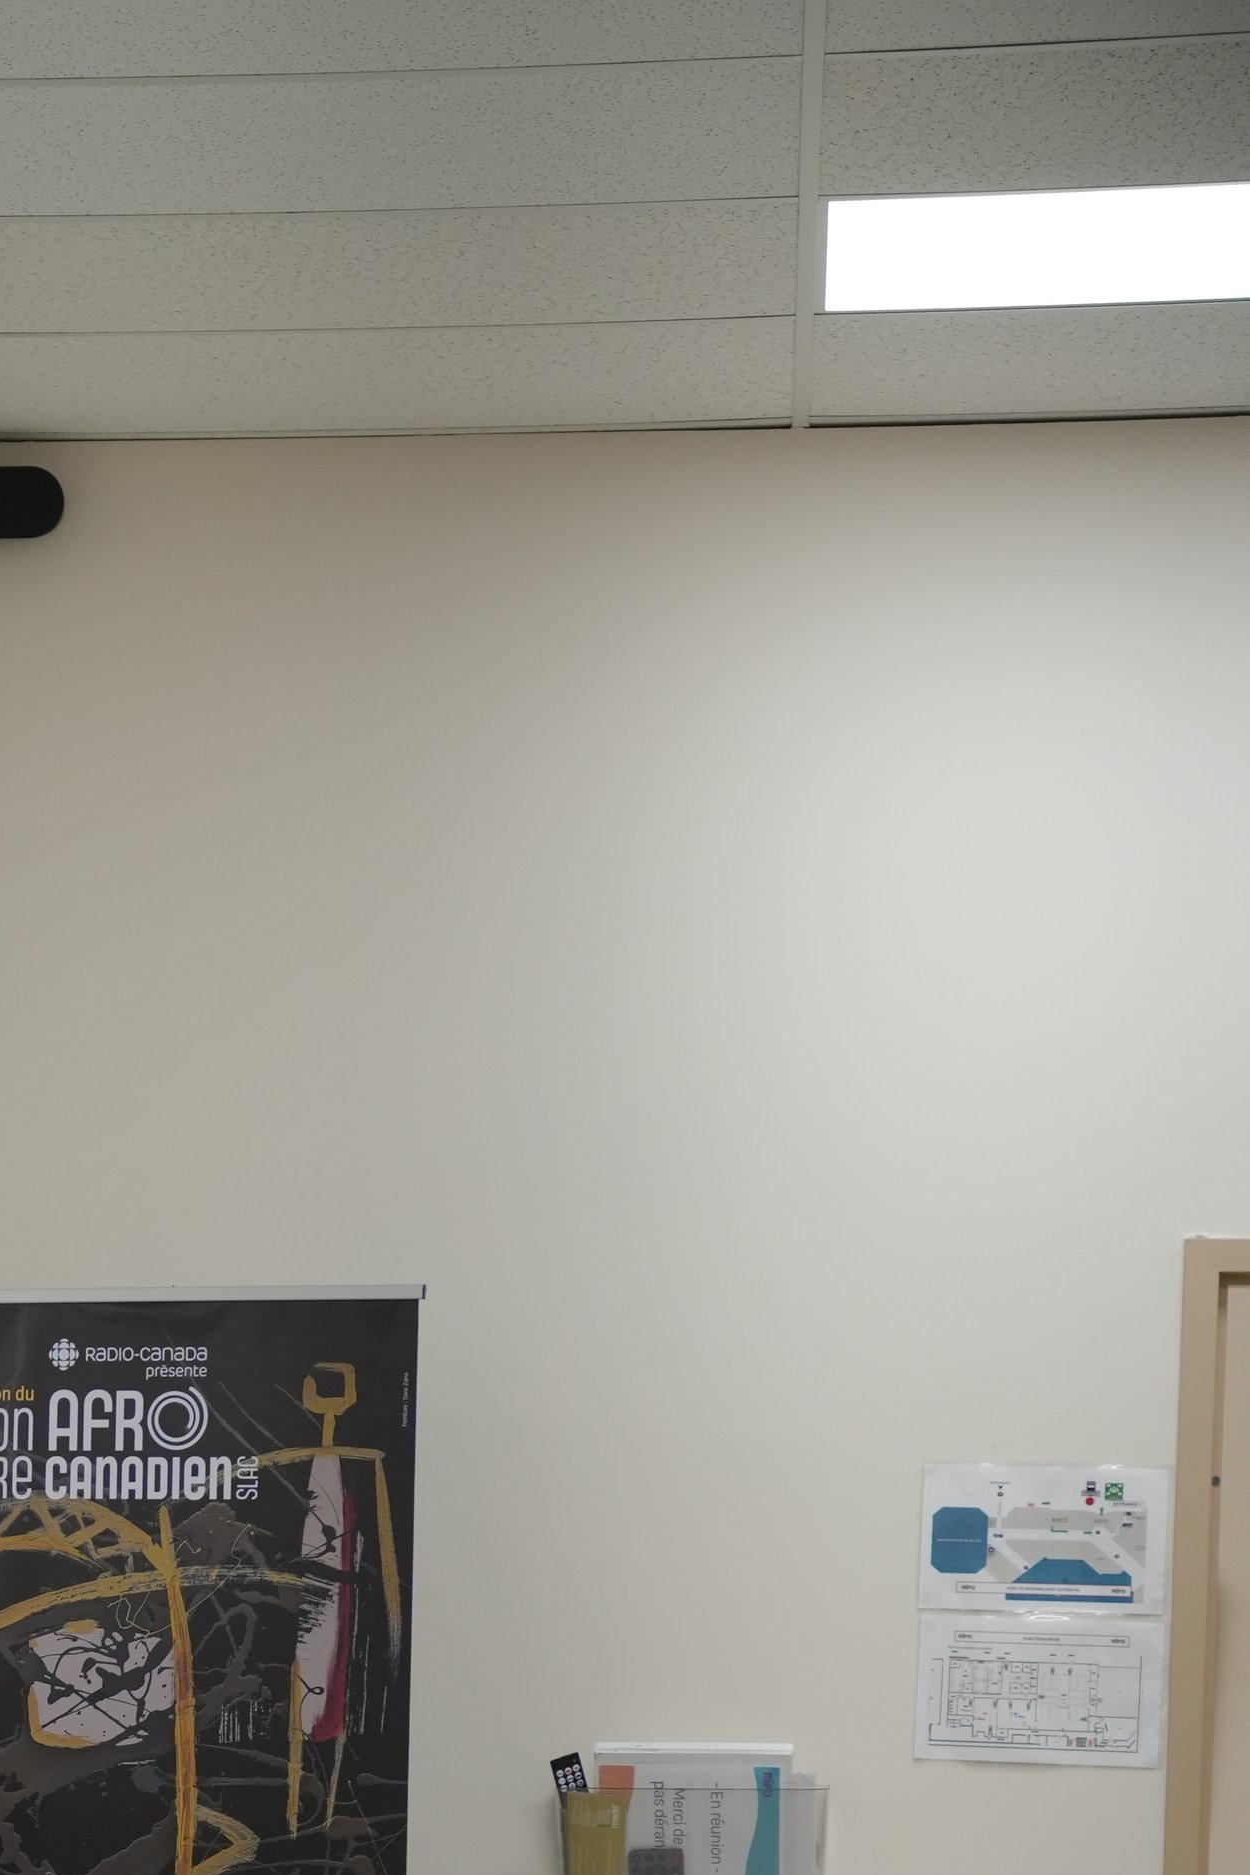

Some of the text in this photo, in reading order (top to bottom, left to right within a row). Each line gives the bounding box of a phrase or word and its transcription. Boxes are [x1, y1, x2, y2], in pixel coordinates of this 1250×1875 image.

[15, 1385, 35, 1402] du
[146, 1364, 208, 1380] présente
[235, 1455, 259, 1501] SLAC
[650, 1781, 668, 1850] pas déran
[673, 1788, 688, 1846] Merci de
[710, 1791, 724, 1809] En
[710, 1816, 726, 1865] réunion
